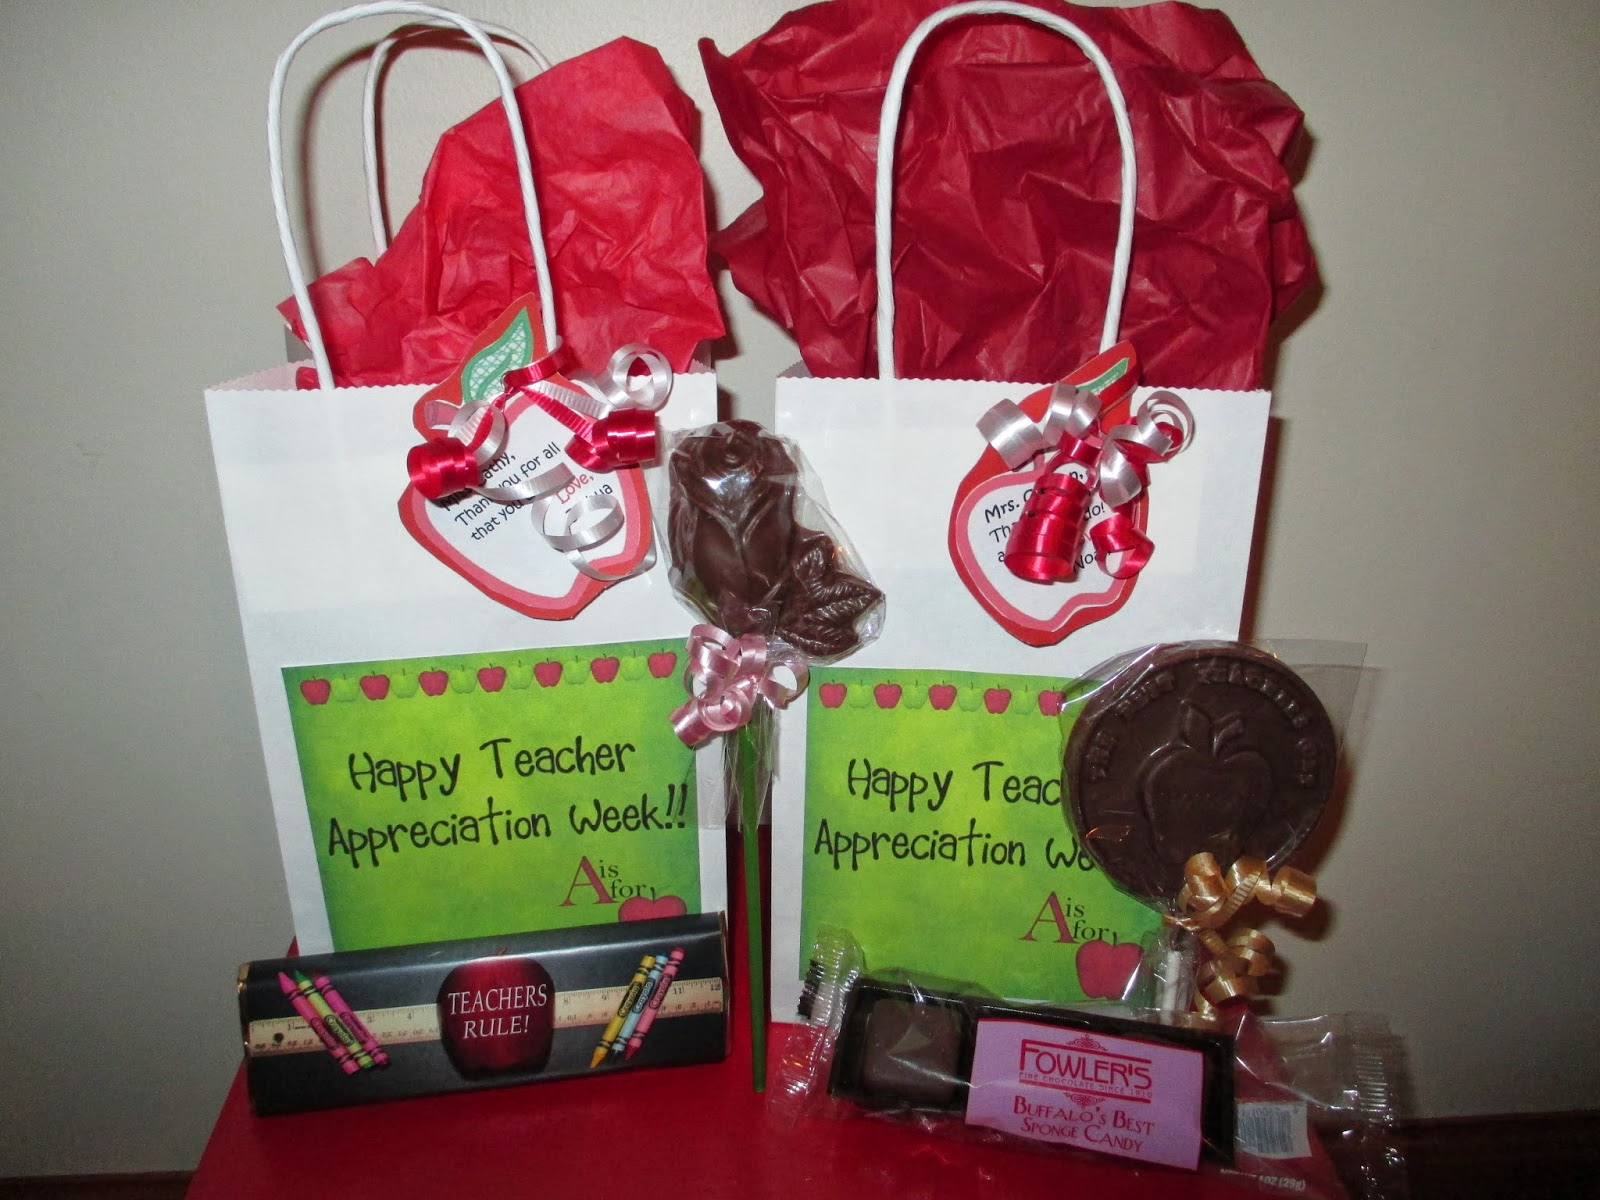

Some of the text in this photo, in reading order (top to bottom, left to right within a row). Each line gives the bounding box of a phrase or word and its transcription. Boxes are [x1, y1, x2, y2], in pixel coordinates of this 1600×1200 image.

[454, 497, 490, 526] Than
[520, 456, 541, 478] for
[542, 441, 561, 459] all
[556, 473, 595, 504] Love,
[471, 500, 524, 541] that you
[984, 499, 1020, 523] Mrs.
[348, 735, 636, 802] Happy Teacher
[847, 758, 1061, 813] Happy Teac
[328, 783, 689, 869] Appreciation Week!!
[814, 818, 1026, 872] Appreciation
[558, 855, 620, 907] A is
[611, 880, 647, 900] for
[1019, 891, 1085, 944] A is
[1071, 920, 1110, 941] for
[448, 983, 548, 1016] TEACHERS
[619, 984, 640, 1017] Crayola
[633, 981, 654, 1012] Crayola
[650, 977, 670, 1009] Crayola
[673, 987, 683, 995] 11
[710, 983, 721, 991] 12
[327, 1015, 355, 1046] Crayola
[463, 1015, 530, 1040] RULE!
[1019, 1039, 1152, 1090] FOWLER'S
[1043, 1076, 1094, 1089] CHOCOLATE
[1096, 1084, 1125, 1094] SINCE
[1013, 1095, 1155, 1135] BUFFALO'S BEST
[1020, 1117, 1144, 1152] SPONGE CANDY
